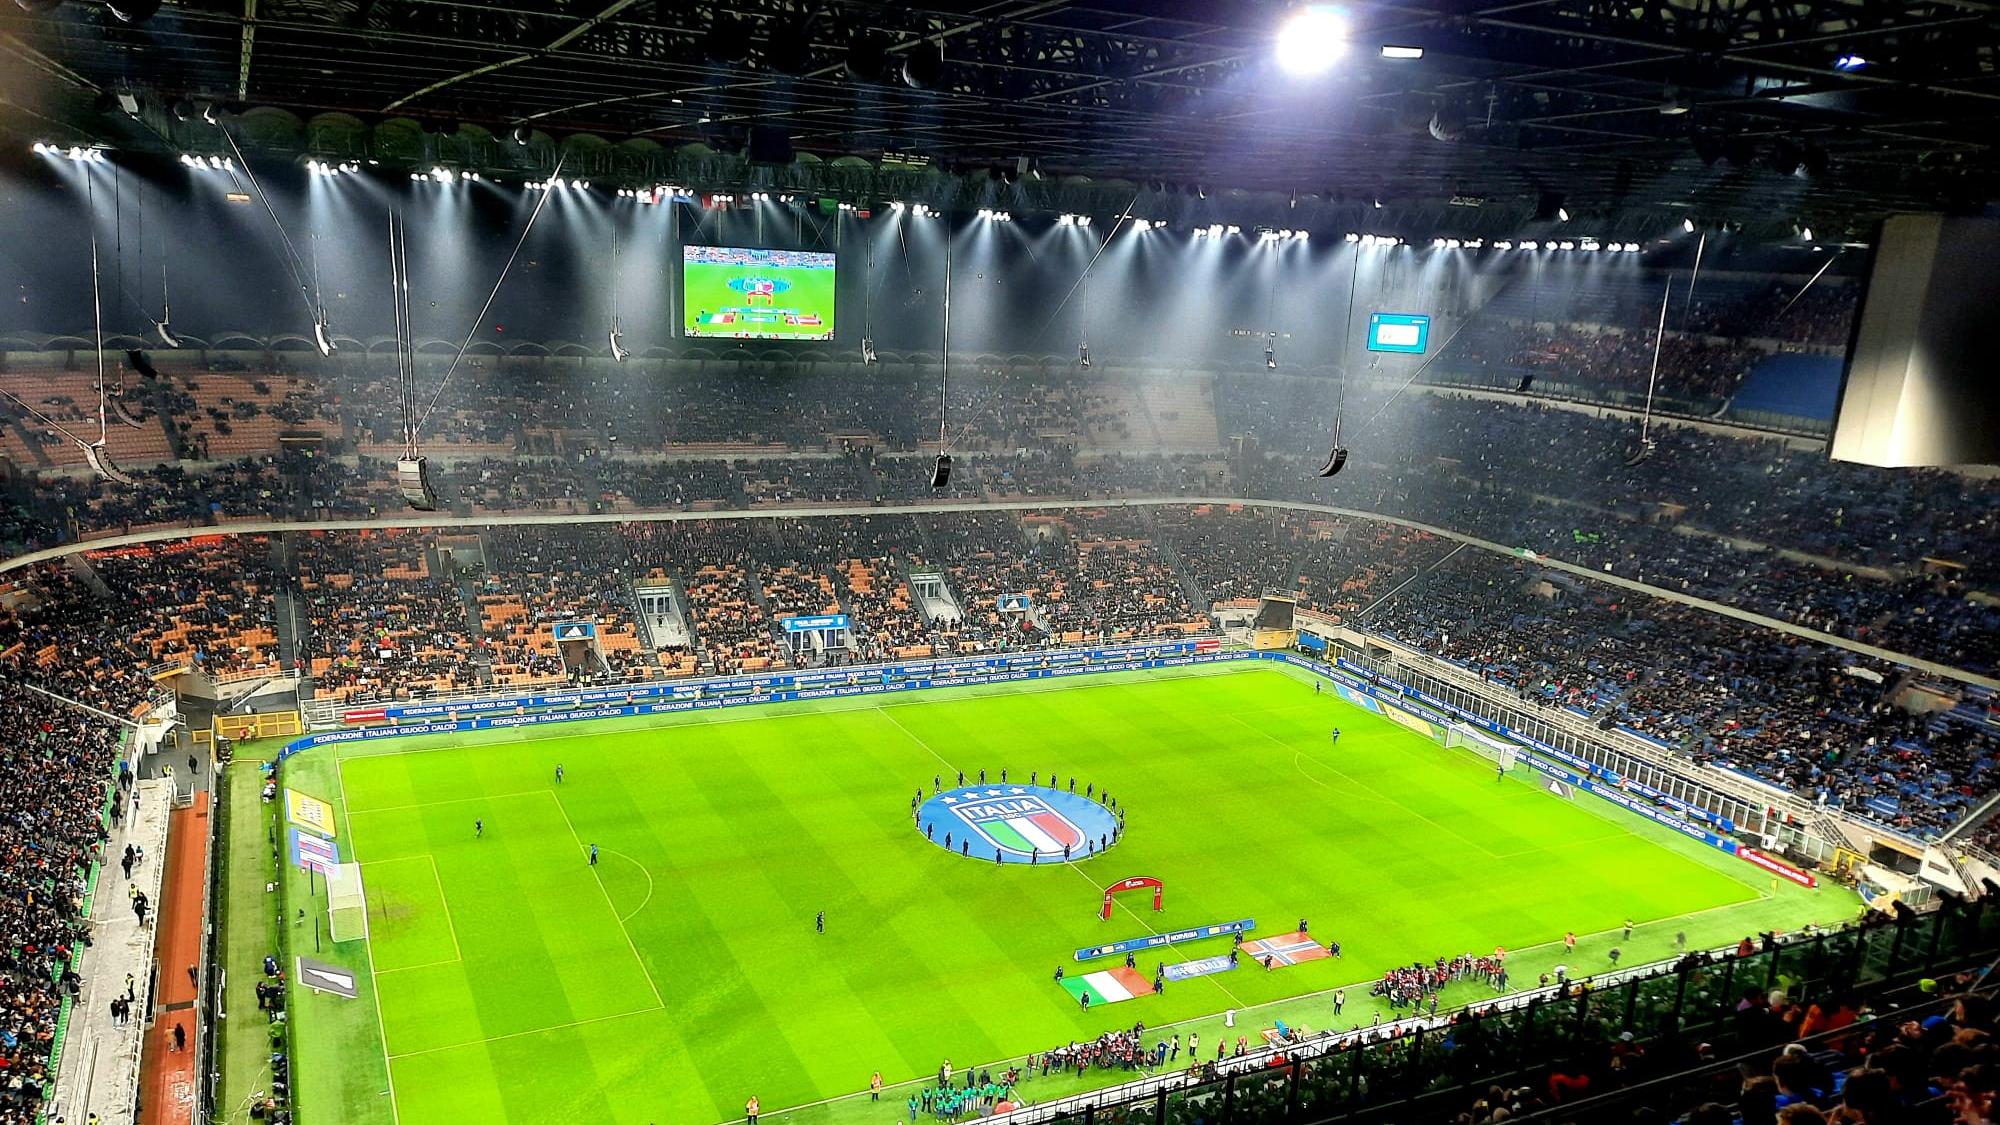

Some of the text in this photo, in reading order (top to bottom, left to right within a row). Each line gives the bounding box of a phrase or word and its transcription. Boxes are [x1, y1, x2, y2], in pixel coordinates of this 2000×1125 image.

[798, 690, 835, 698] FEDERAZIONE
[403, 707, 443, 715] FEDERAZIONE
[652, 703, 693, 711] FEDERAZIONE
[491, 716, 537, 726] FEDERAZIONE
[314, 732, 363, 743] FEDERAZIONE
[366, 729, 398, 737] ITALIANA
[400, 726, 429, 734] GIUOCO
[960, 800, 1042, 819] ITALIA
[1591, 785, 1706, 838] FEDERAZIONE ITALIANA GIUOCO CALCIO
[1148, 931, 1198, 945] ITALIA NORVEGIA
